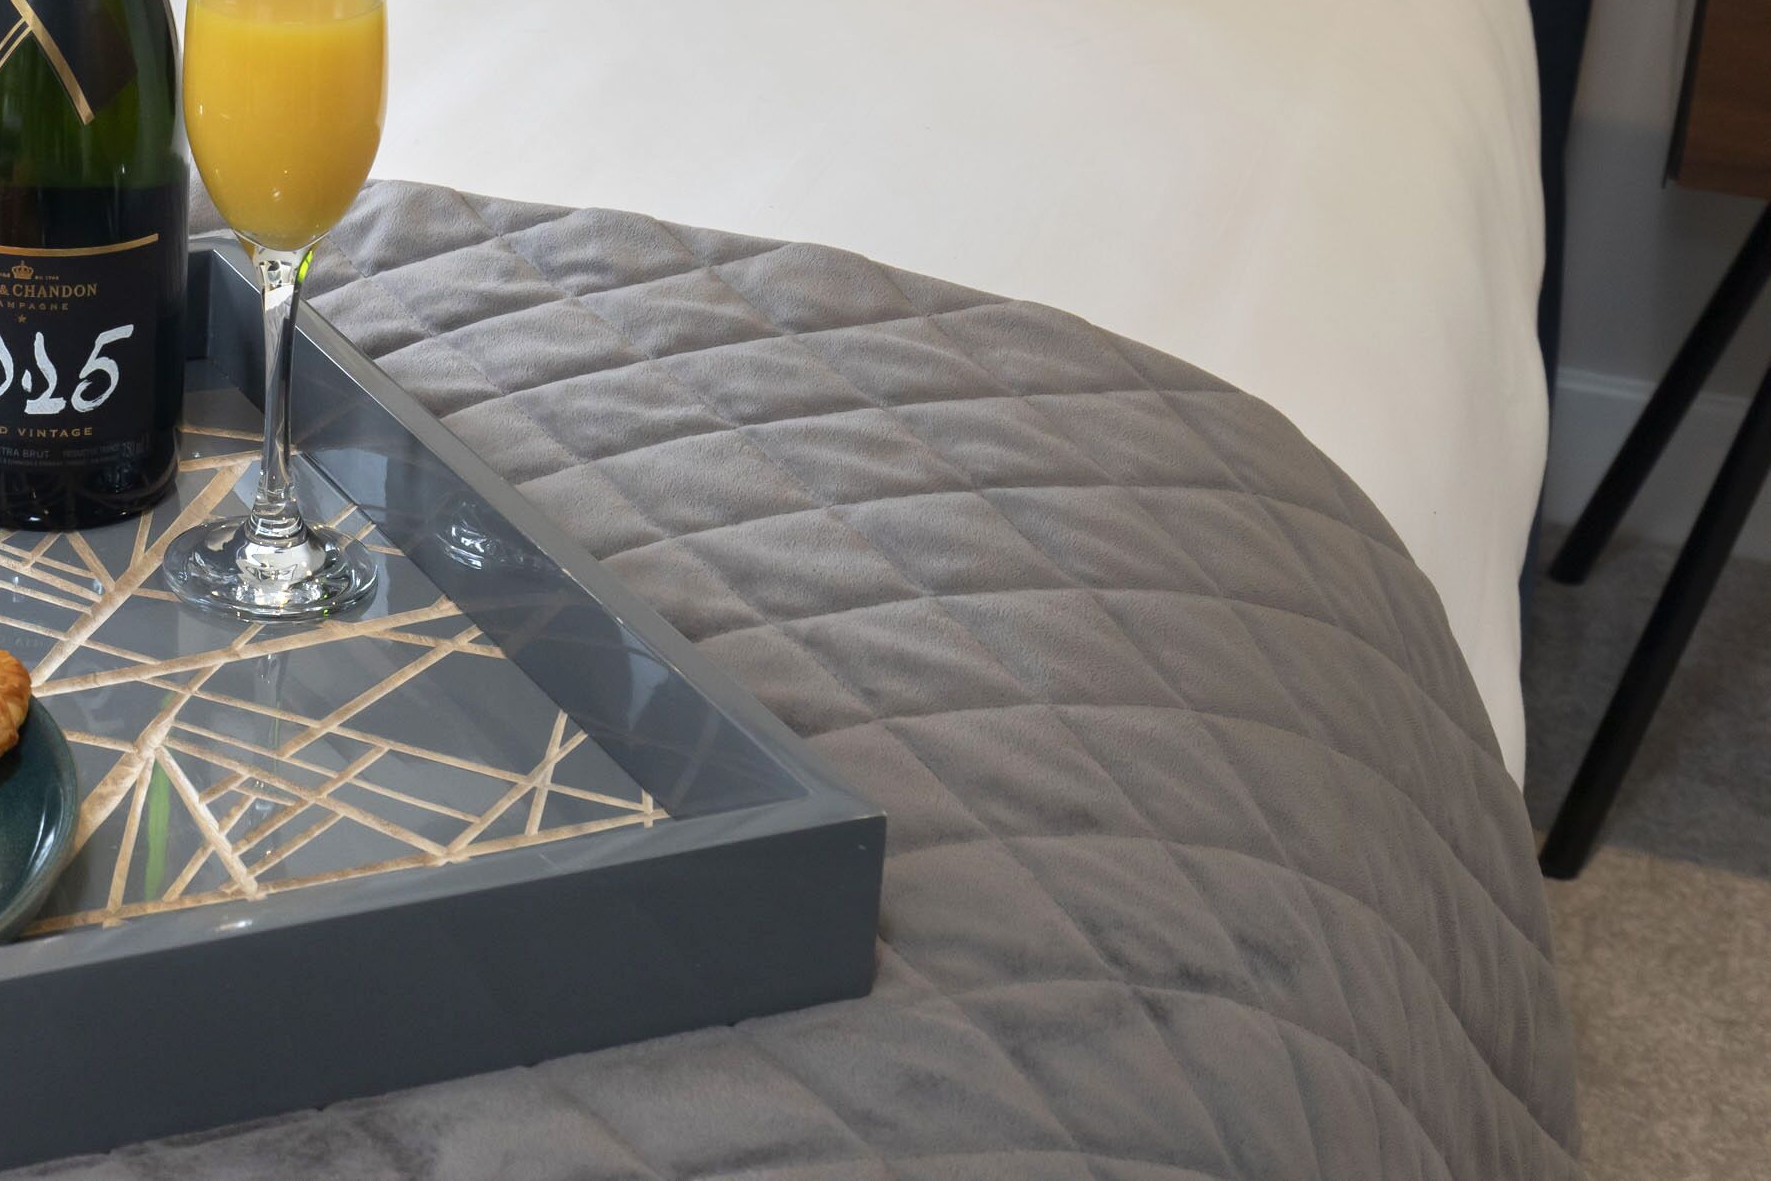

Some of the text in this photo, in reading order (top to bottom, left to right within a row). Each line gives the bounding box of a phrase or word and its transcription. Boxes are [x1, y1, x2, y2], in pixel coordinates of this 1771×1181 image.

[0, 284, 9, 296] &
[12, 283, 98, 298] CHANDON
[18, 427, 93, 439] VINTAGE
[23, 448, 50, 459] BRUT
